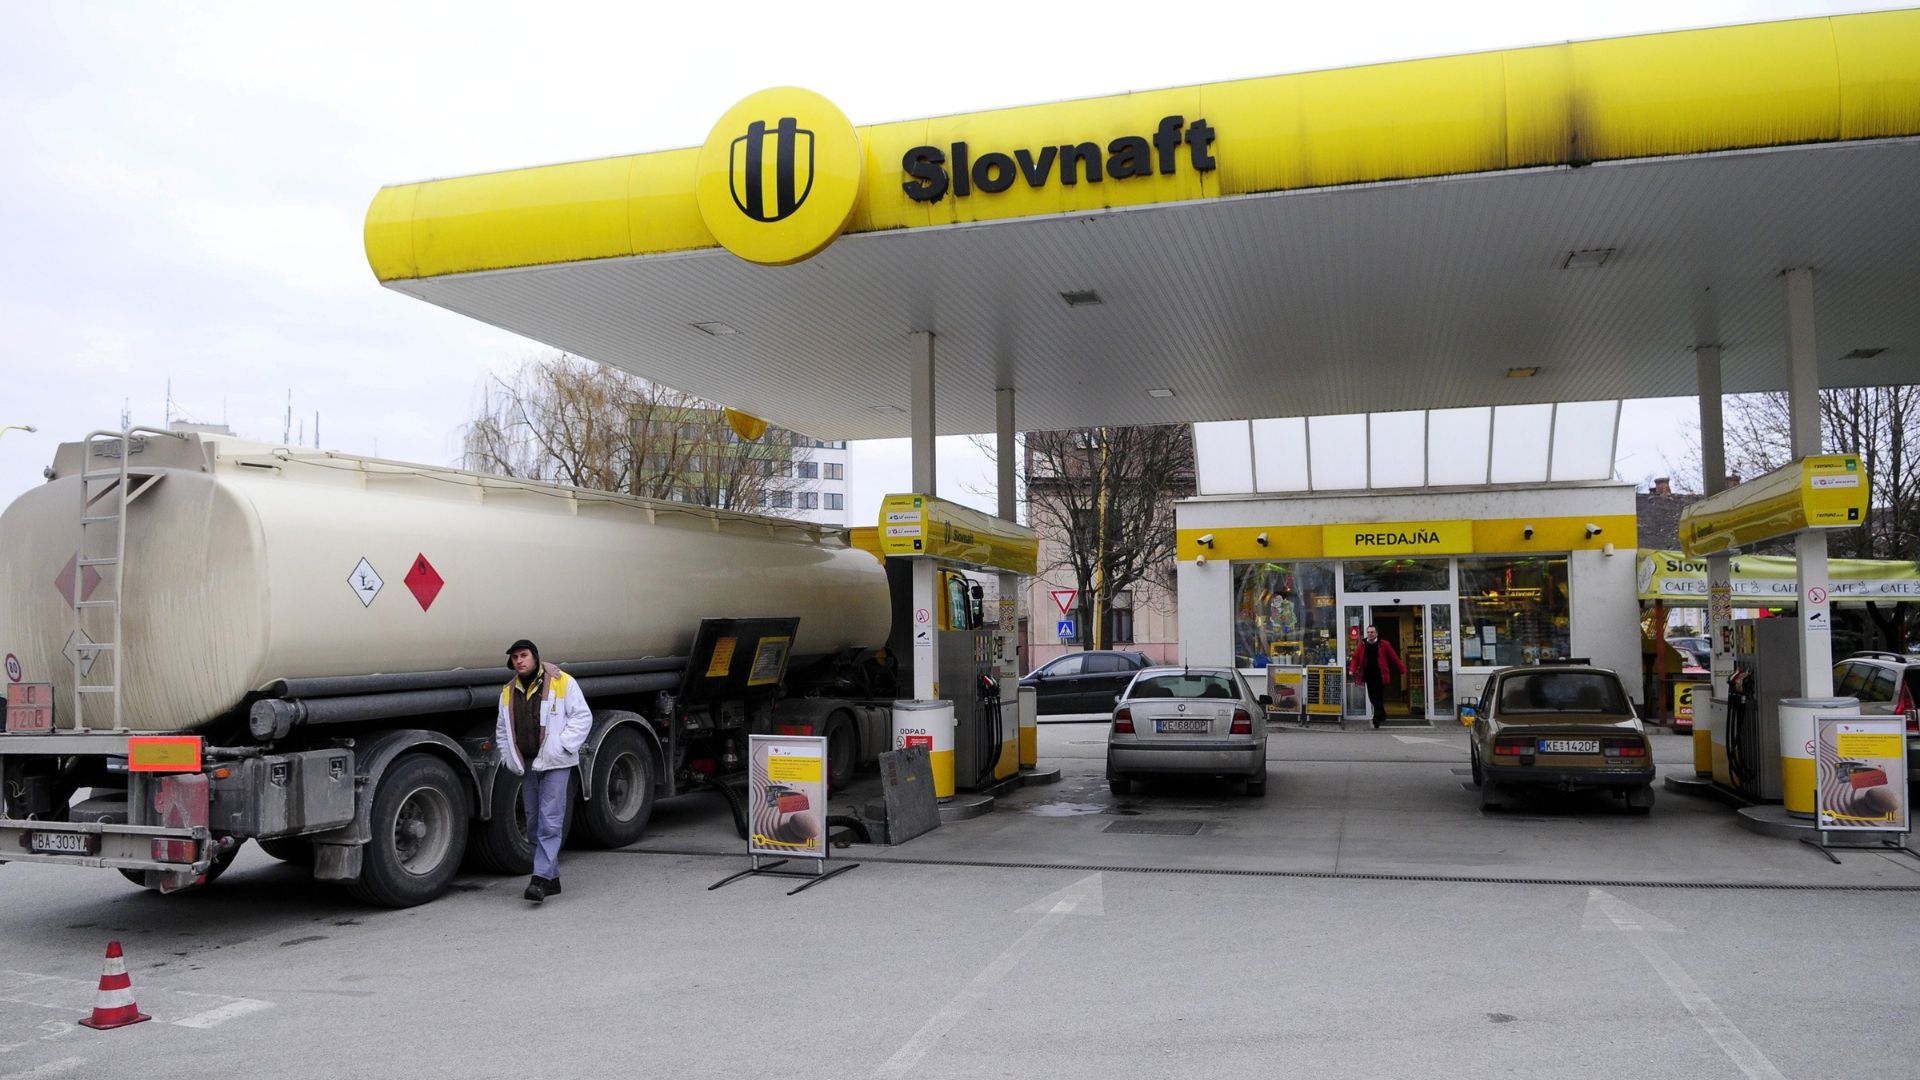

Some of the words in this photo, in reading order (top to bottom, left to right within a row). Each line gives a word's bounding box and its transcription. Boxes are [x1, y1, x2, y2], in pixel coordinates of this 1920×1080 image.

[902, 115, 1216, 203] Slovnaft
[1355, 528, 1440, 546] PREDAJŇA
[1665, 582, 1694, 591] CAFE
[1881, 584, 1910, 593] CAFE
[9, 662, 18, 674] 80
